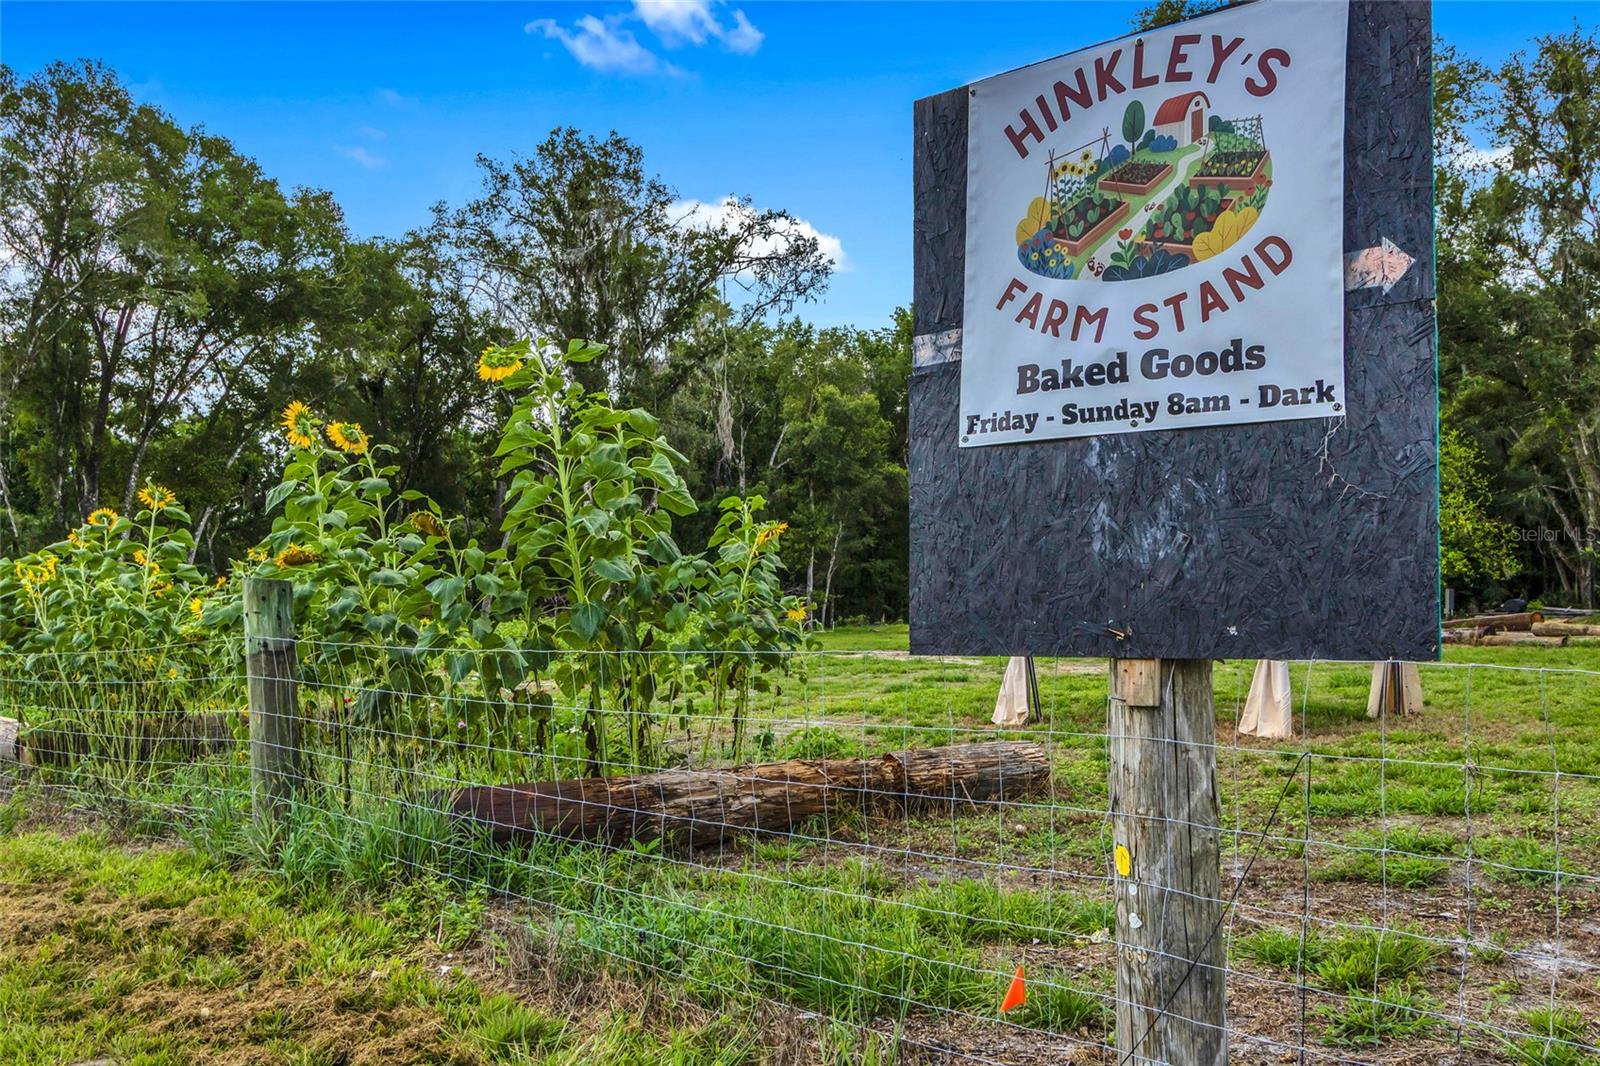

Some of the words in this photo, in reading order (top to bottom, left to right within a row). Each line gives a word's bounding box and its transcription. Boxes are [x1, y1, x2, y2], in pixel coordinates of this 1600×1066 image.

[1003, 33, 1291, 159] HINKLEY'S
[995, 277, 1109, 343] FARM
[1133, 235, 1293, 340] STAND
[966, 411, 1039, 436] Friday
[1062, 398, 1159, 424] Sunday
[1167, 393, 1231, 415] 8am
[1258, 379, 1335, 408] Dark
[1016, 351, 1129, 395] Baked
[1140, 338, 1266, 380] Goods
